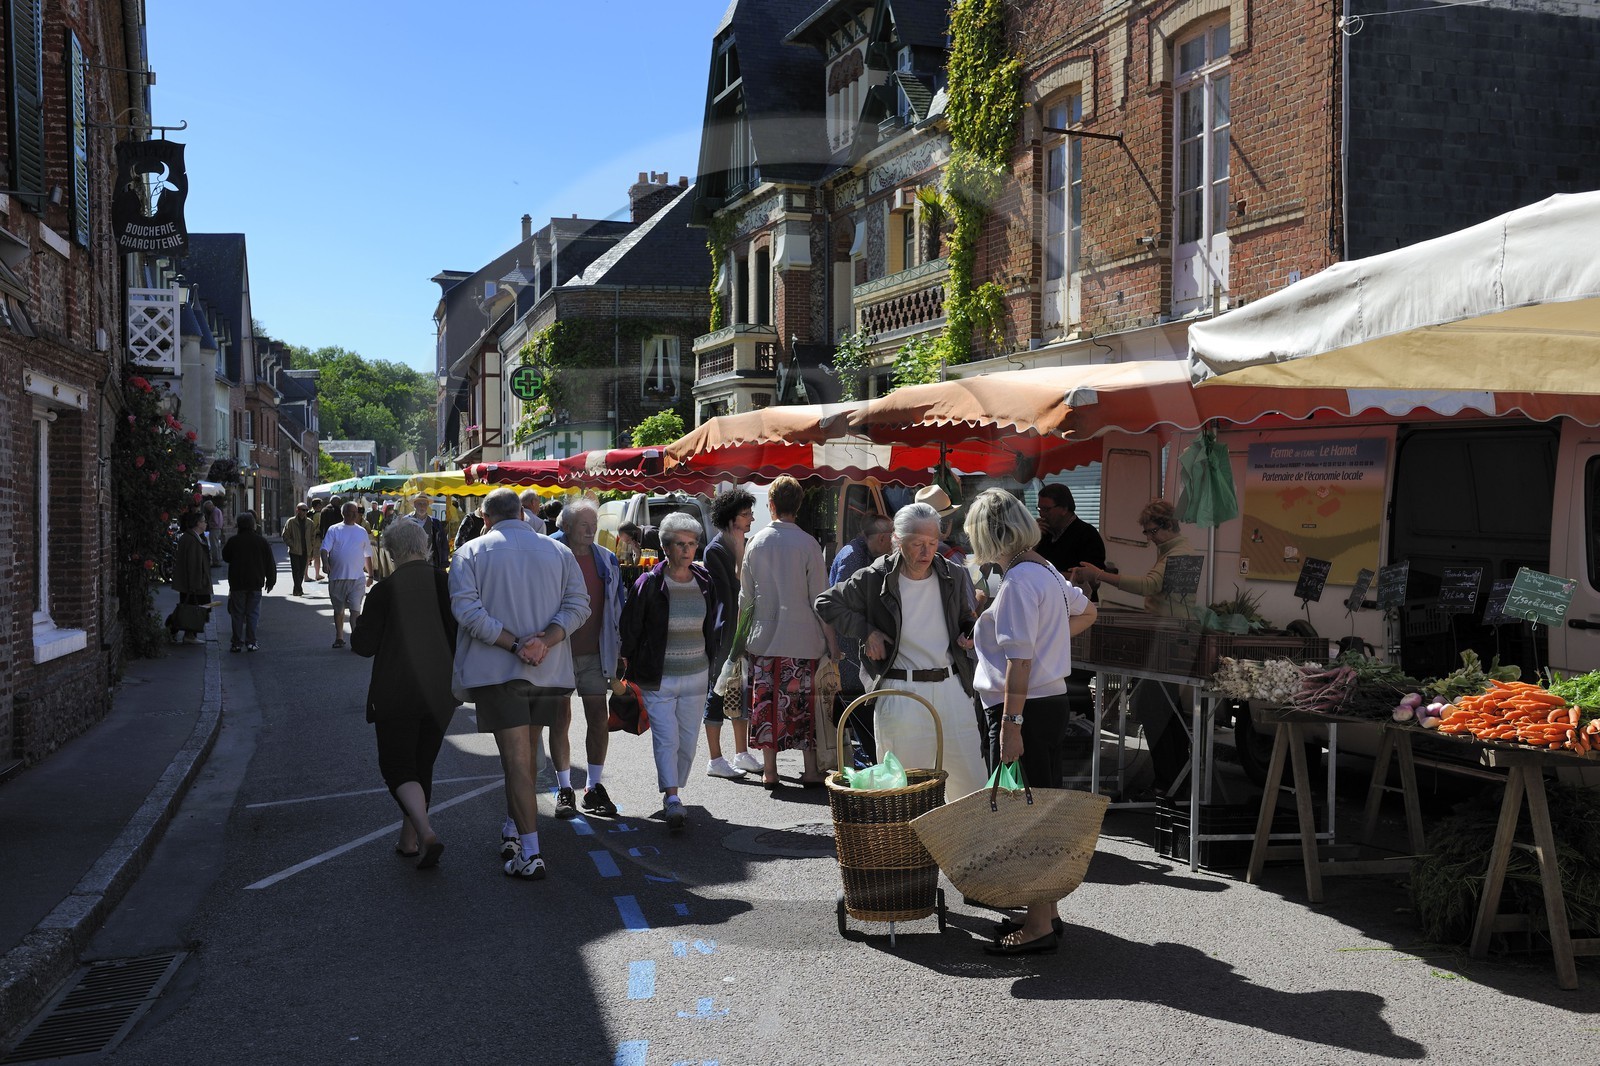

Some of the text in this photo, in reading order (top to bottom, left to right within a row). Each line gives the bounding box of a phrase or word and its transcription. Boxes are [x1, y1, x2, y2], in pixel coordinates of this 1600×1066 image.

[125, 222, 176, 236] BOUCHERIE
[120, 234, 184, 249] CHARCUTERIE
[1270, 447, 1294, 458] Ferme
[1320, 445, 1330, 456] Le
[1331, 444, 1358, 456] Hamel
[1262, 469, 1364, 481] Partenaire de l'économie locale
